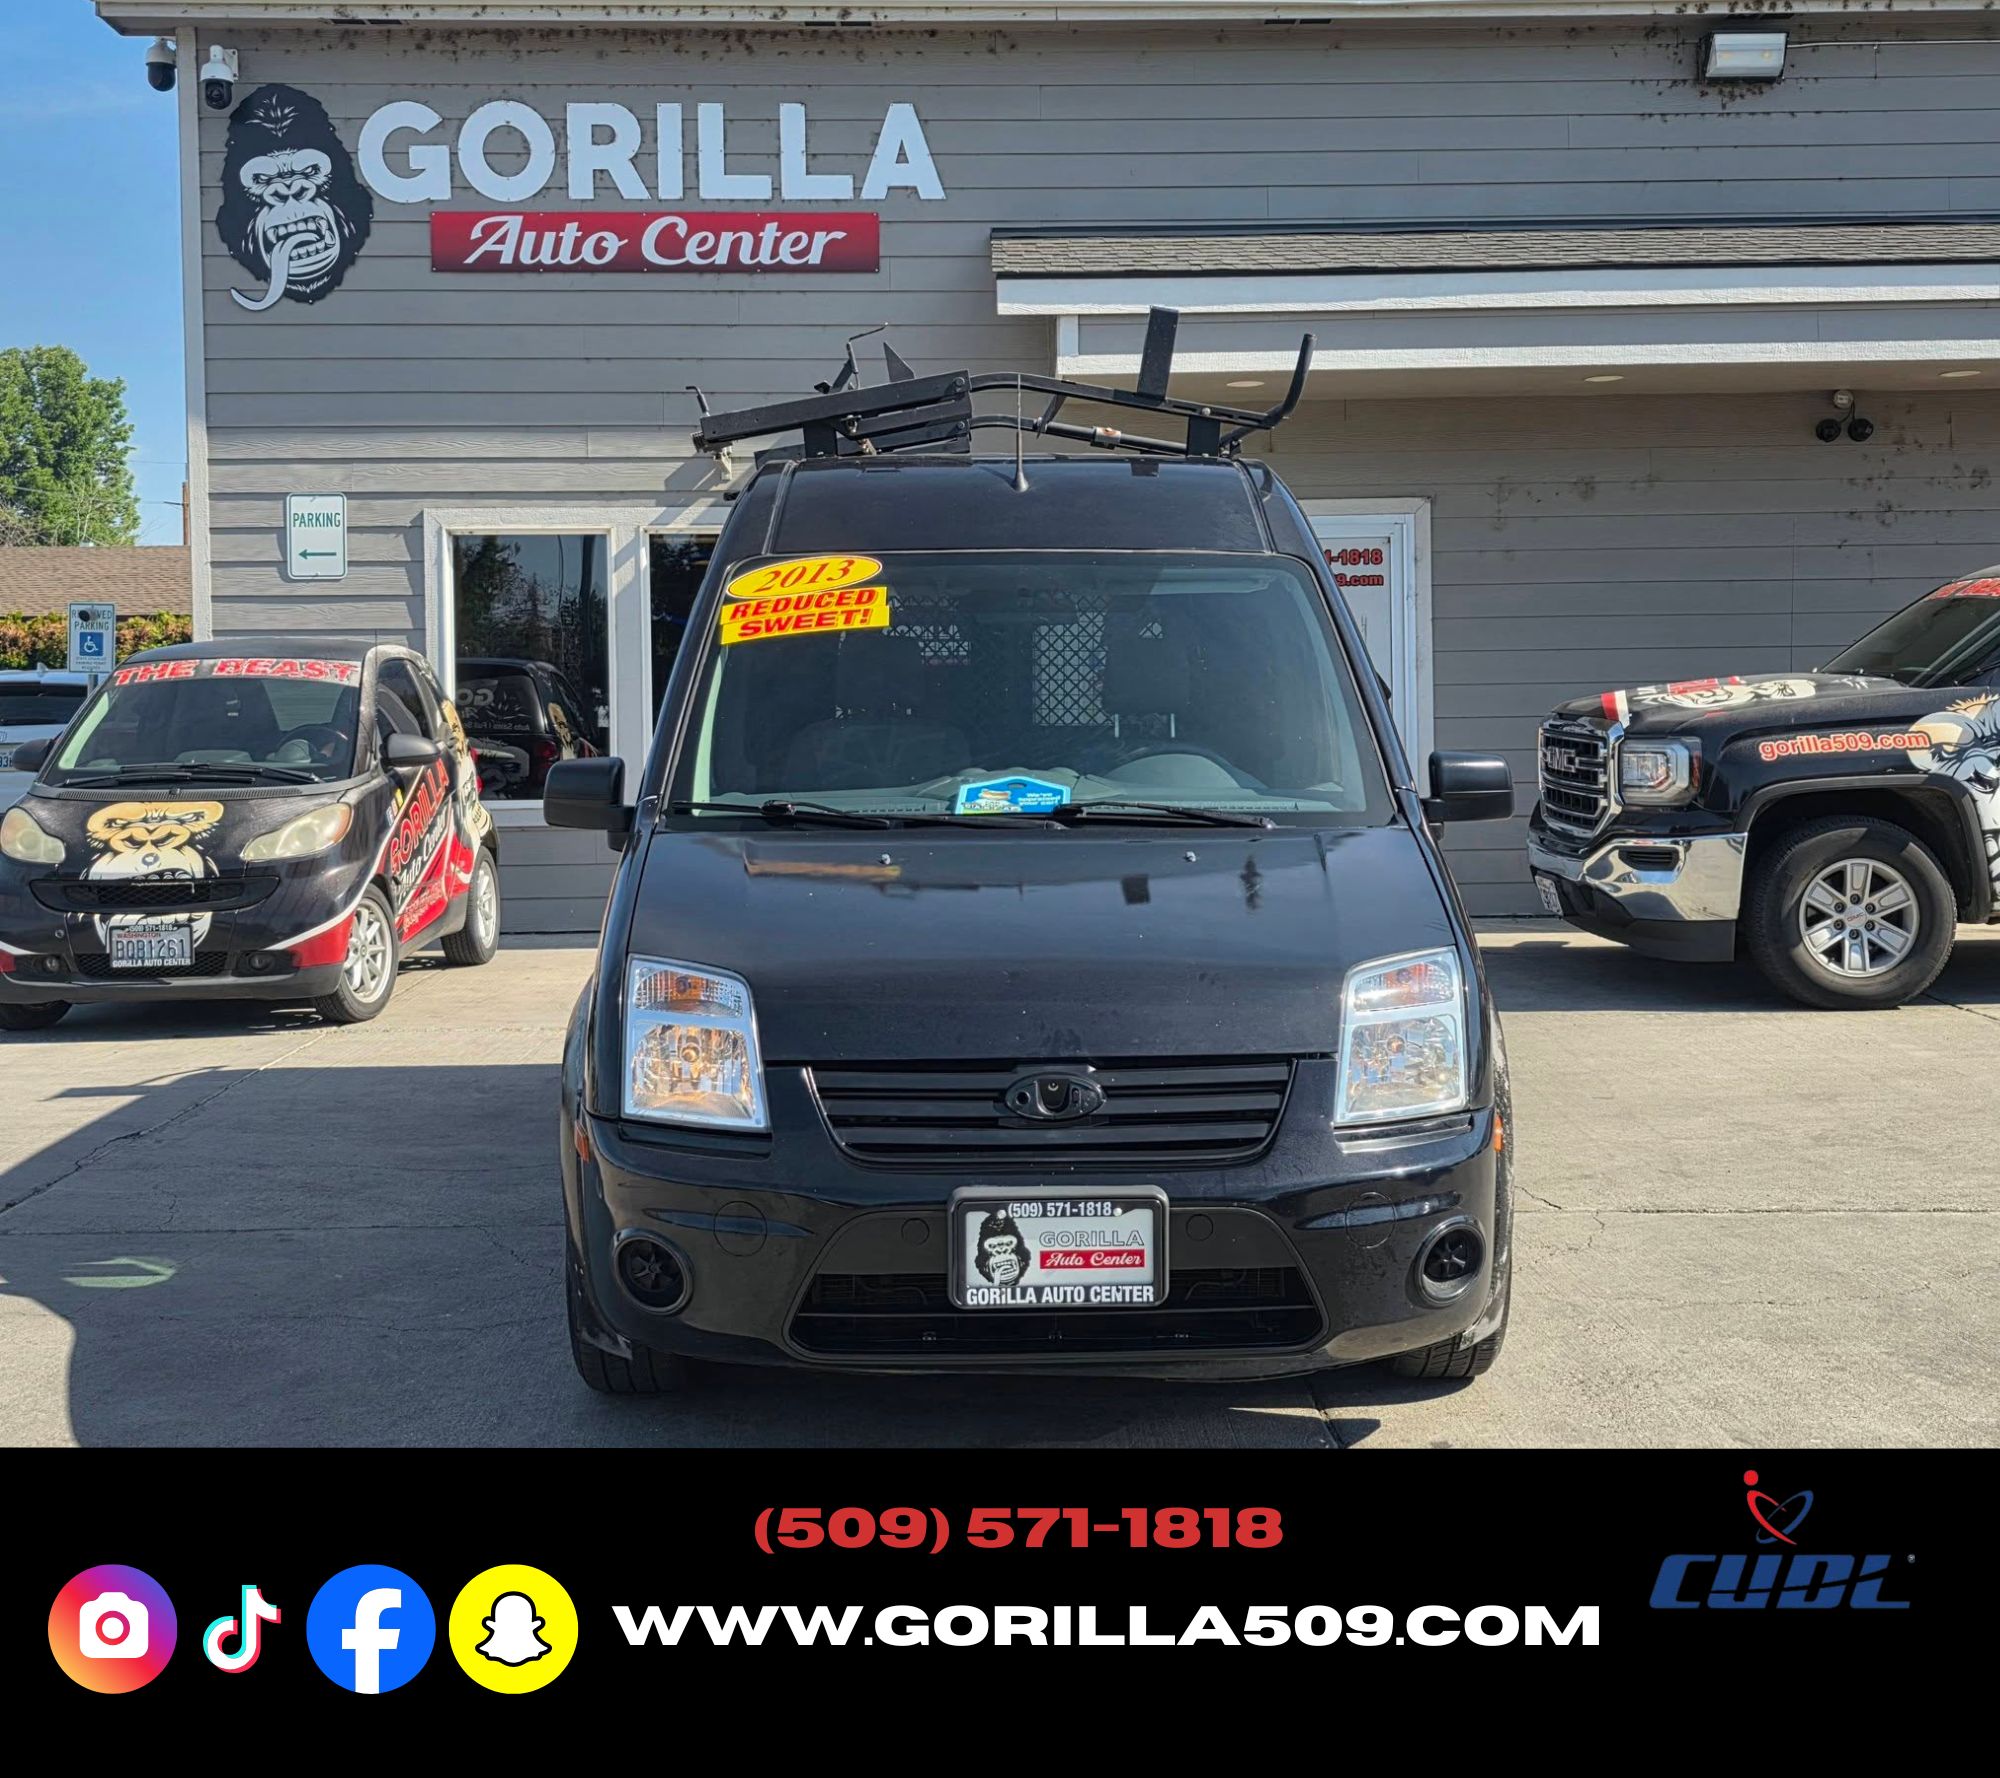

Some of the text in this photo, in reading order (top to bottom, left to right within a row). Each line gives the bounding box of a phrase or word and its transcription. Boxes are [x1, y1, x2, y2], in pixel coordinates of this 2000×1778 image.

[357, 100, 946, 203] GORILLA
[463, 214, 848, 266] Auto Center
[292, 512, 341, 528] PARKING
[752, 559, 856, 594] 2013
[729, 588, 877, 621] REDUCED
[74, 621, 110, 631] PARKING
[737, 608, 873, 638] SWEET!
[114, 658, 359, 686] THE BEAST
[1760, 732, 1930, 763] gorilla509.com
[390, 757, 449, 877] GORILLA
[112, 958, 191, 968] GORILLA AUTO CENTER
[1008, 1202, 1112, 1218] (509) 571-1818
[1039, 1230, 1145, 1248] GORILLA
[1045, 1251, 1142, 1267] Auto Center
[966, 1285, 1154, 1305] GORILLA AUTO CENTER
